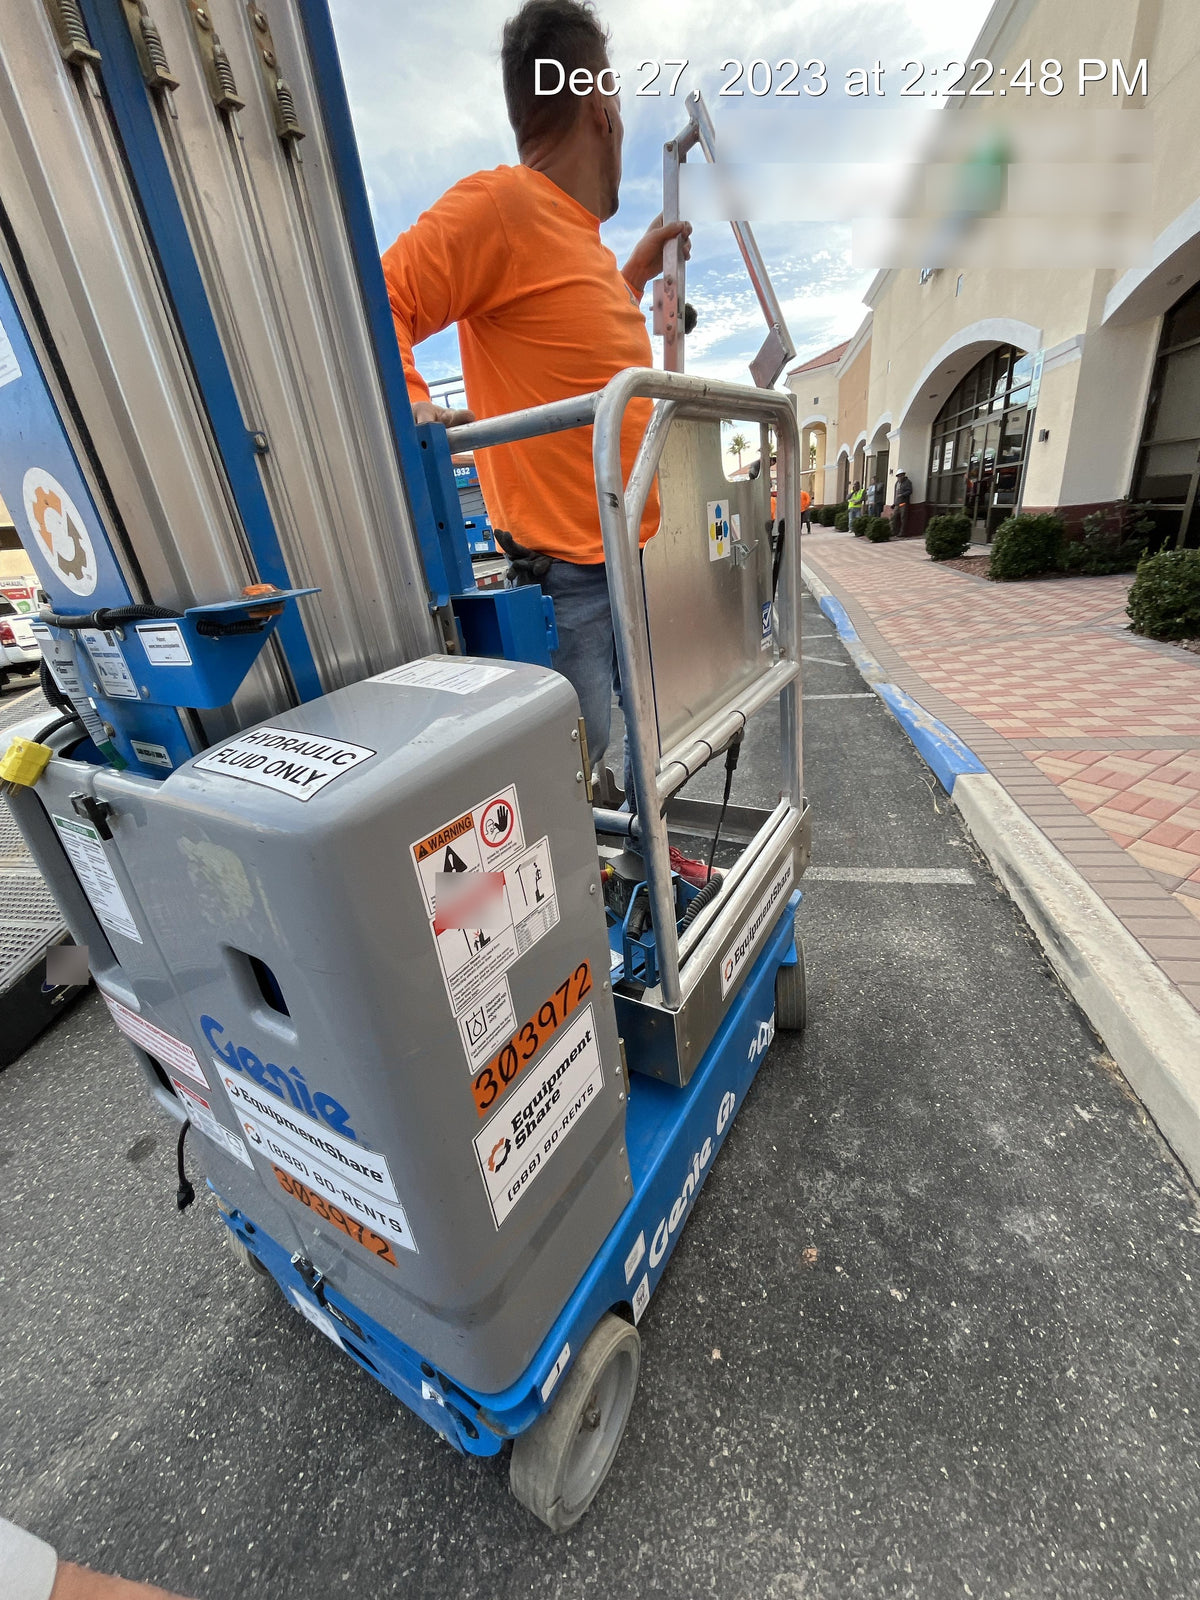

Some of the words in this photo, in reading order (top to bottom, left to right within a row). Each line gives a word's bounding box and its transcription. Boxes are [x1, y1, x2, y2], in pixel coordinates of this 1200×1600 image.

[210, 748, 266, 770] FLUID
[263, 760, 327, 788] ONLY
[240, 731, 356, 767] HYDRAULIC
[427, 816, 472, 851] WARNING
[734, 867, 791, 966] EquipmentShare
[200, 1014, 357, 1140] Genie
[474, 962, 591, 1110] 303972
[511, 1030, 593, 1135] Equipment
[239, 1087, 384, 1183] EquipmentShare
[507, 1156, 541, 1202] (888)
[544, 1084, 594, 1154] 80-RENTS
[515, 1089, 561, 1152] Share
[266, 1139, 310, 1178] (888)
[312, 1171, 403, 1233] 80-RENTS
[273, 1166, 390, 1260] 303972
[650, 1137, 711, 1268] Genie
